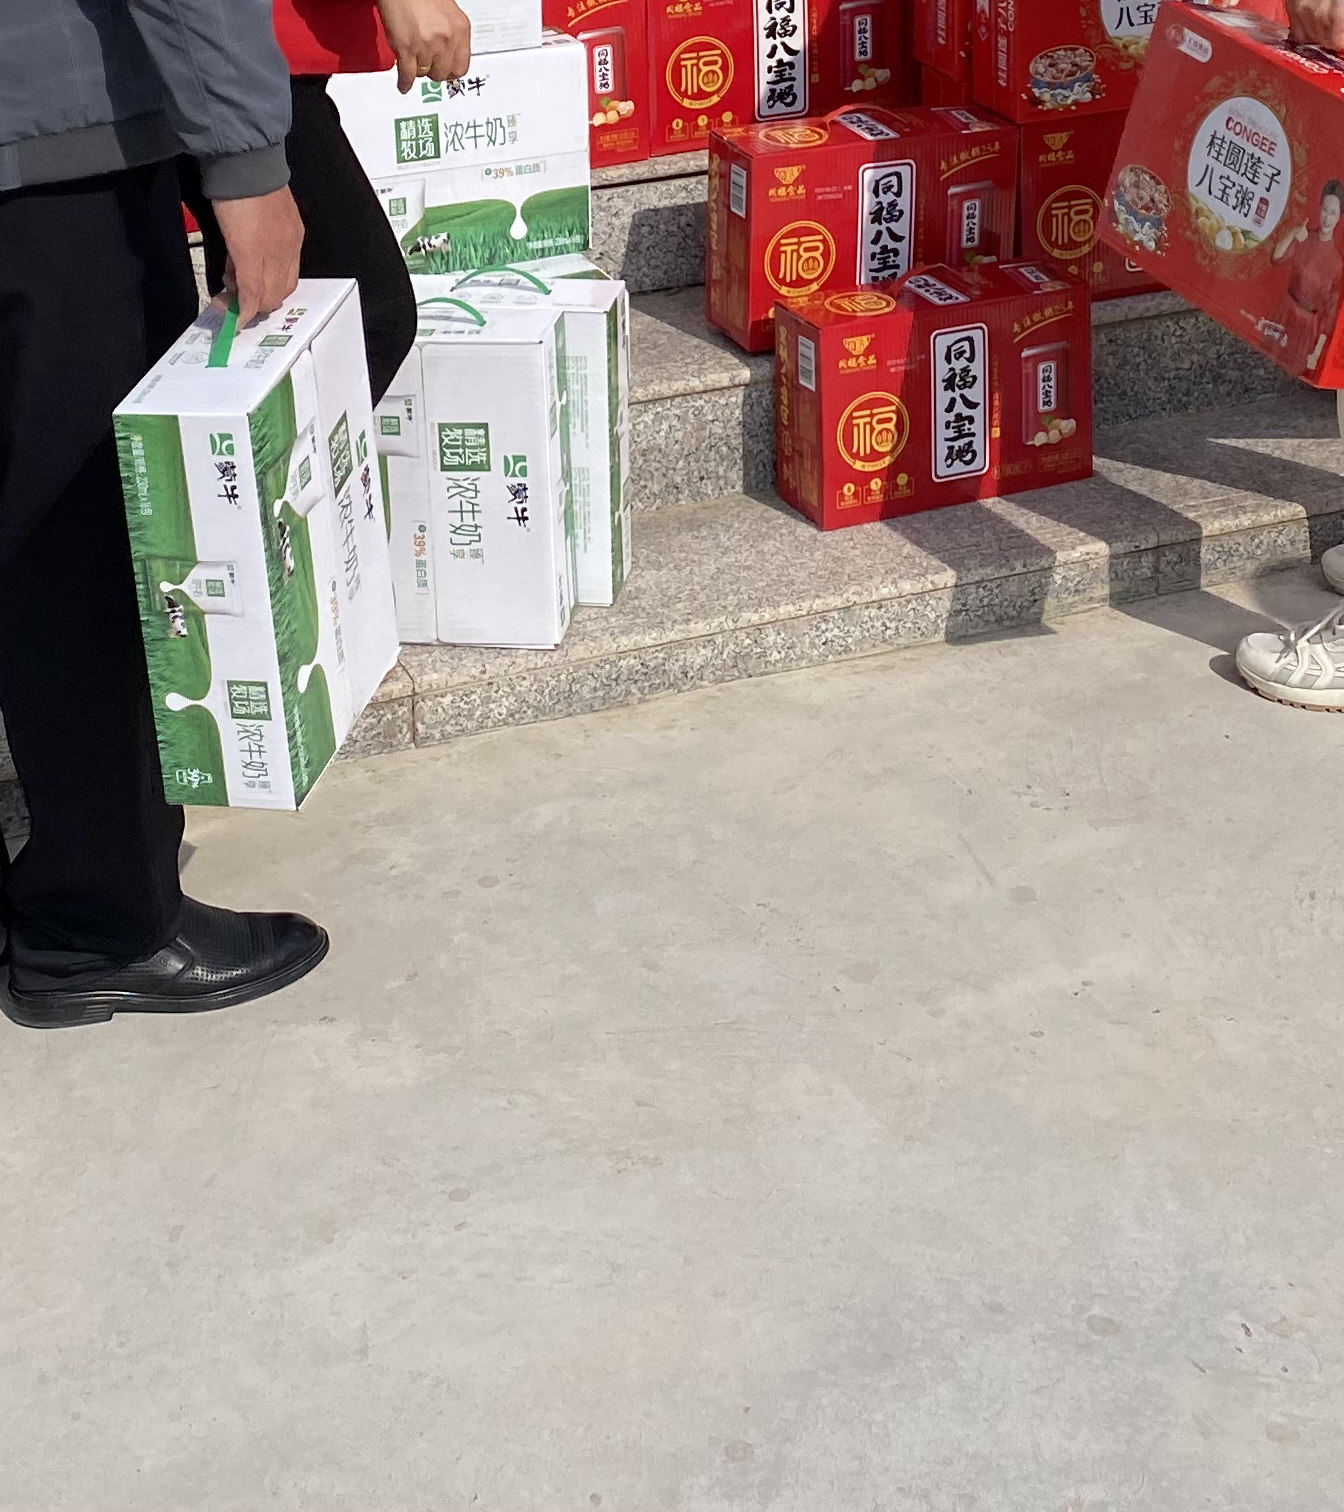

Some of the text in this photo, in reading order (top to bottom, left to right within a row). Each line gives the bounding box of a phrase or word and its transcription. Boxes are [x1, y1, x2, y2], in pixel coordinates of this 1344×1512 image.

[1114, 0, 1157, 31] 八宝
[679, 49, 723, 95] 福
[398, 116, 435, 140] 精选
[400, 138, 435, 160] 牧场
[443, 116, 506, 154] 浓牛奶
[1224, 115, 1278, 158] CONGEE
[1205, 129, 1282, 194] 桂圆莲子
[1195, 163, 1256, 218] 八宝粥
[868, 171, 906, 282] 同福八宝
[1051, 198, 1094, 246] 福
[779, 231, 824, 283] 福
[941, 335, 982, 469] 同福八宝粥
[441, 427, 466, 466] 牧场
[464, 427, 488, 466] 精选
[851, 406, 899, 458] 福
[214, 460, 240, 506] 蒙牛
[505, 482, 530, 528] 蒙牛
[446, 476, 483, 547] 浓牛奶
[235, 721, 270, 780] 浓牛奶
